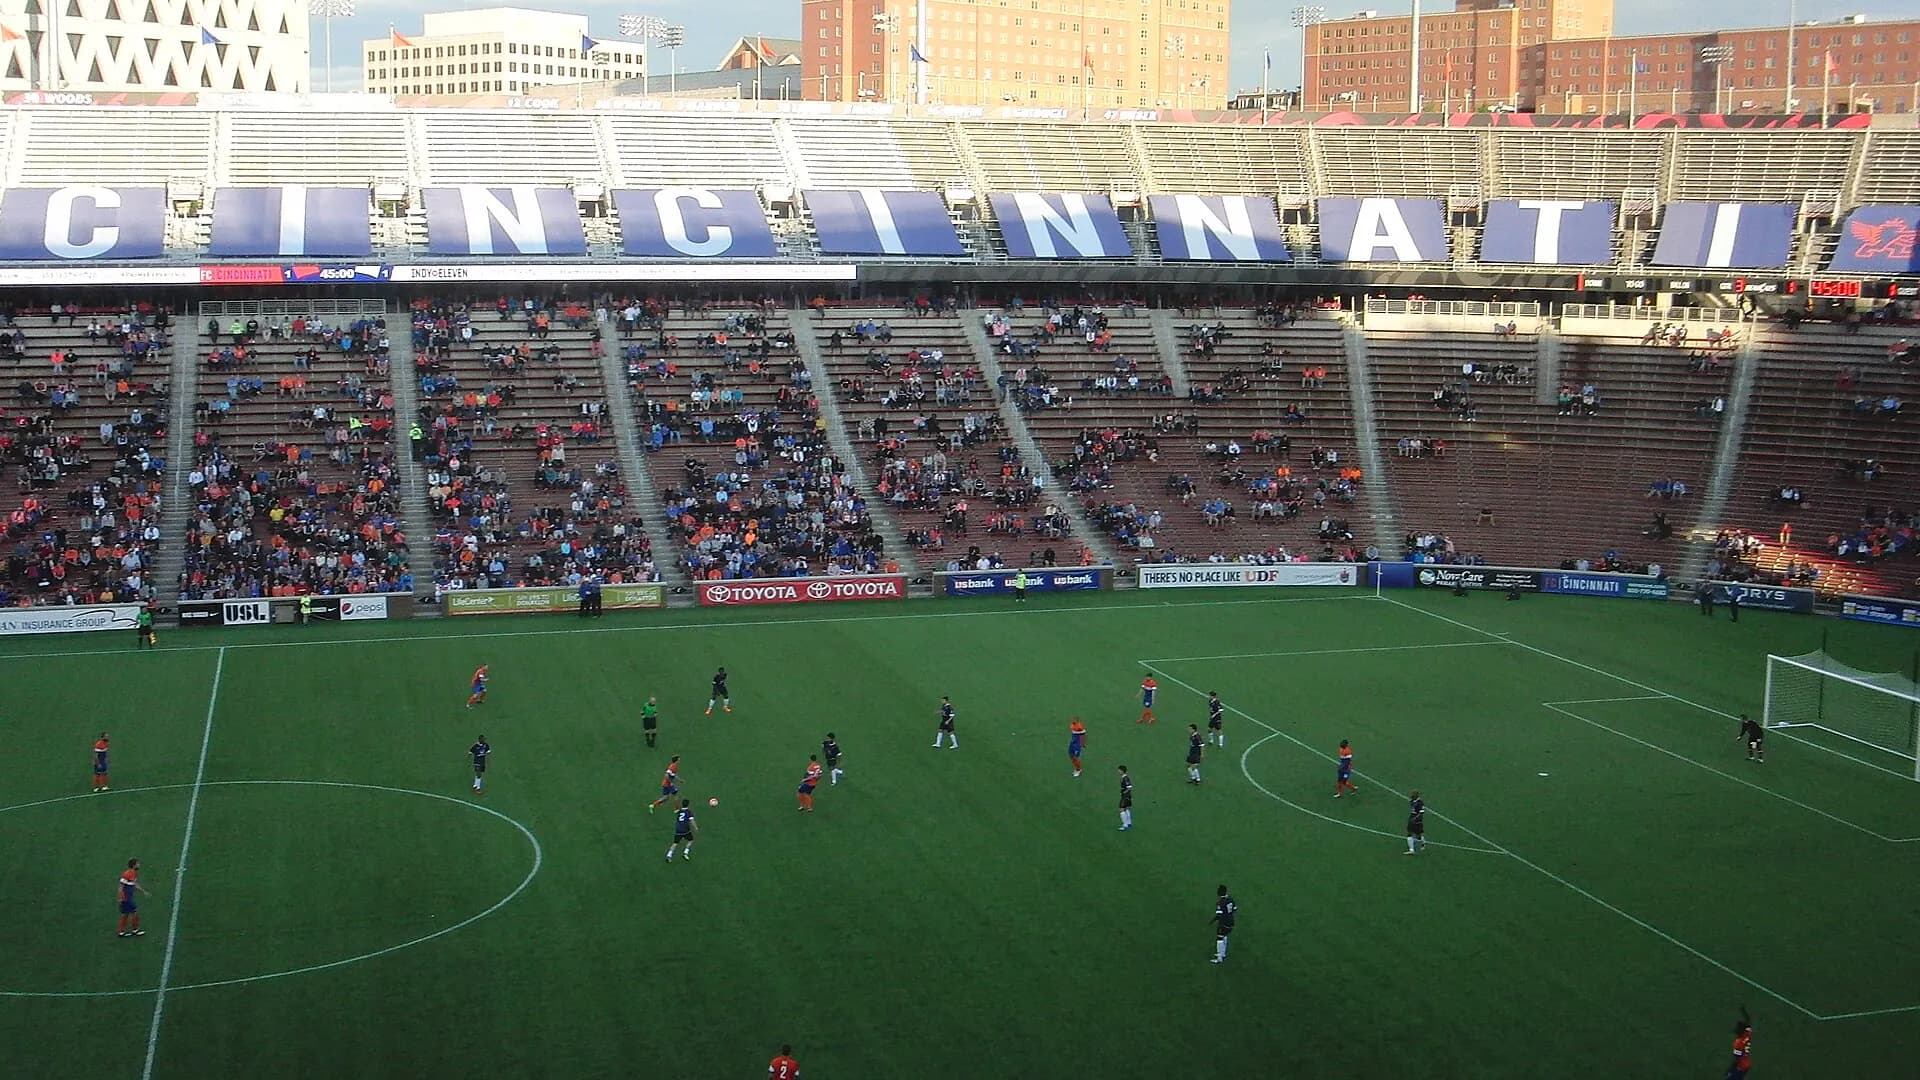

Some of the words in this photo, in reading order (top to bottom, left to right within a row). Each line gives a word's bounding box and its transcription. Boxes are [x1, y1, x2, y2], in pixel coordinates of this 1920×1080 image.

[44, 185, 1742, 267] CINCINNATI
[200, 269, 214, 281] FC
[284, 269, 292, 279] 1
[319, 267, 355, 280] 45:00
[381, 269, 389, 279] 1
[410, 268, 433, 279] INDY
[438, 267, 469, 278] ELEVEN
[1735, 279, 1745, 293] 3
[1811, 281, 1859, 296] 45:00
[954, 577, 996, 589] usbank
[1004, 575, 1045, 588] usank
[1053, 573, 1093, 585] usbank
[1143, 572, 1177, 584] THERE'S
[1178, 571, 1193, 583] NO
[1194, 571, 1221, 583] PLACE
[1222, 571, 1241, 582] LIKE
[1244, 570, 1279, 582] UDF
[832, 581, 898, 597] TOYOTA
[1562, 577, 1619, 592] CINCINNATI
[562, 592, 581, 602] LifeC
[731, 586, 798, 601] TOYOTA
[224, 603, 267, 622] USL
[355, 602, 386, 615] pepsi
[22, 618, 74, 631] INSURANCE
[76, 617, 107, 629] GROUP
[678, 812, 686, 822] 2
[779, 1065, 787, 1079] 2
